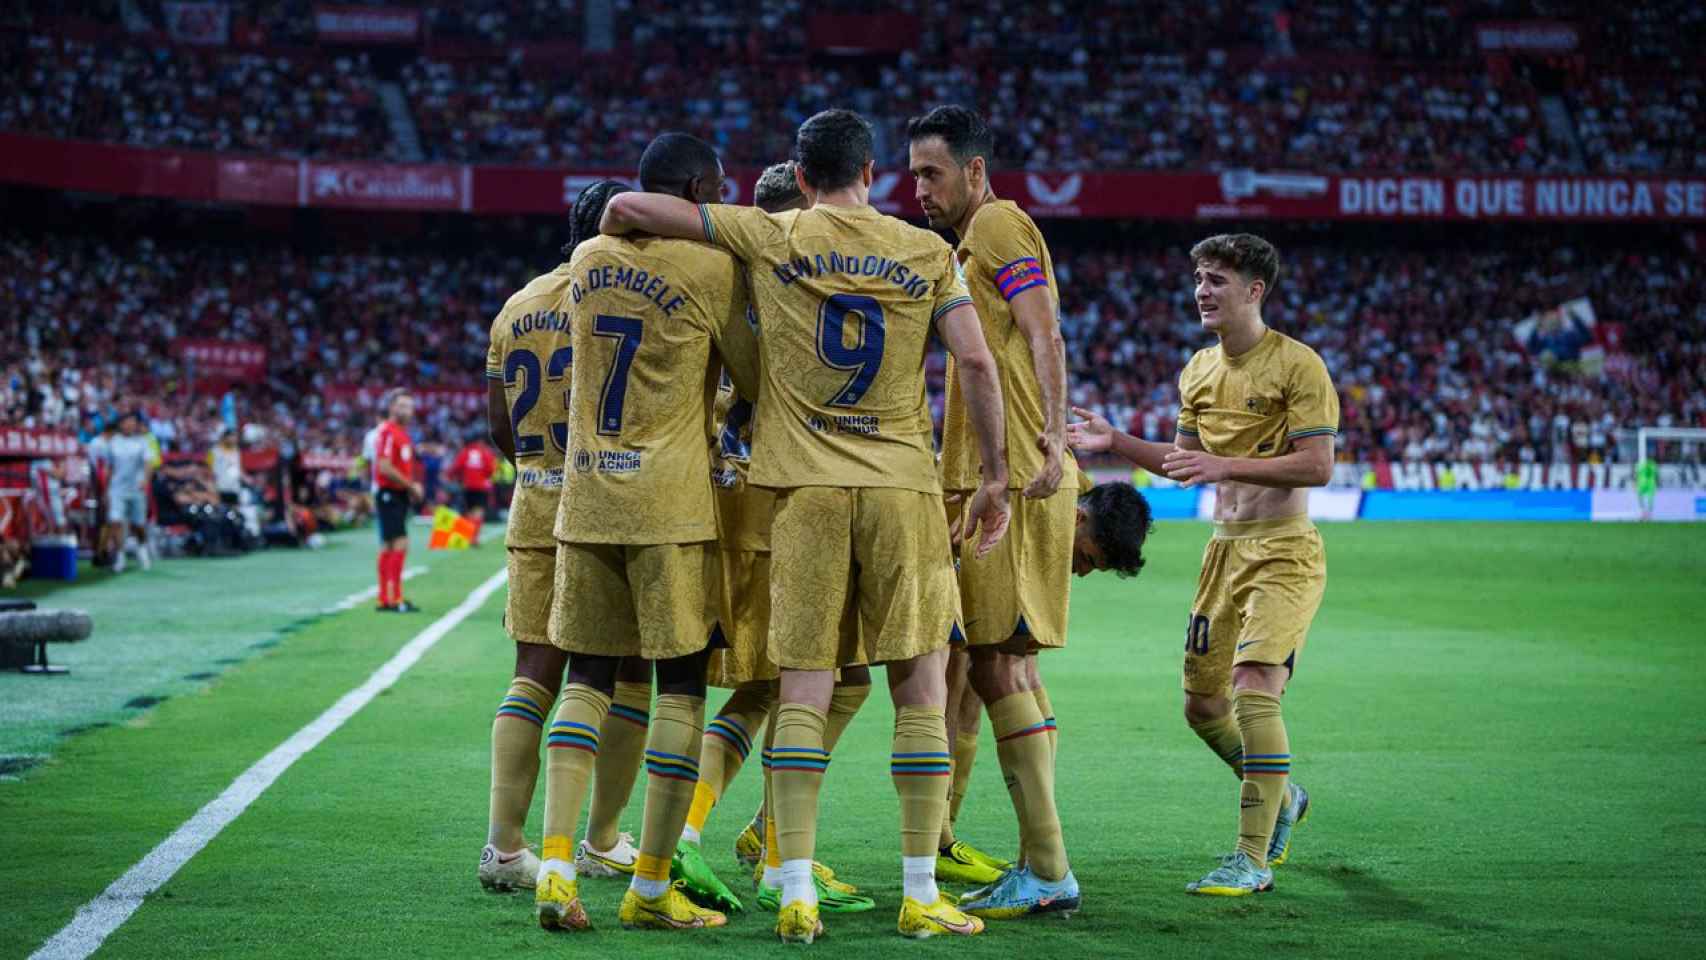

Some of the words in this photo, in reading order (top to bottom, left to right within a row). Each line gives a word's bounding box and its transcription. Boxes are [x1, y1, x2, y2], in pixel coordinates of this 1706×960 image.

[1339, 177, 1444, 215] DICEN
[1456, 178, 1524, 217] QUE
[1536, 179, 1654, 216] NUNCA
[1664, 180, 1706, 216] SE
[773, 250, 929, 299] LEWANDOWSKI
[572, 282, 586, 304] O.
[815, 293, 886, 408] 9
[592, 313, 645, 436] 7
[833, 415, 880, 425] UNHCR
[599, 449, 641, 461] UNHCR
[599, 459, 641, 471] ACNUR
